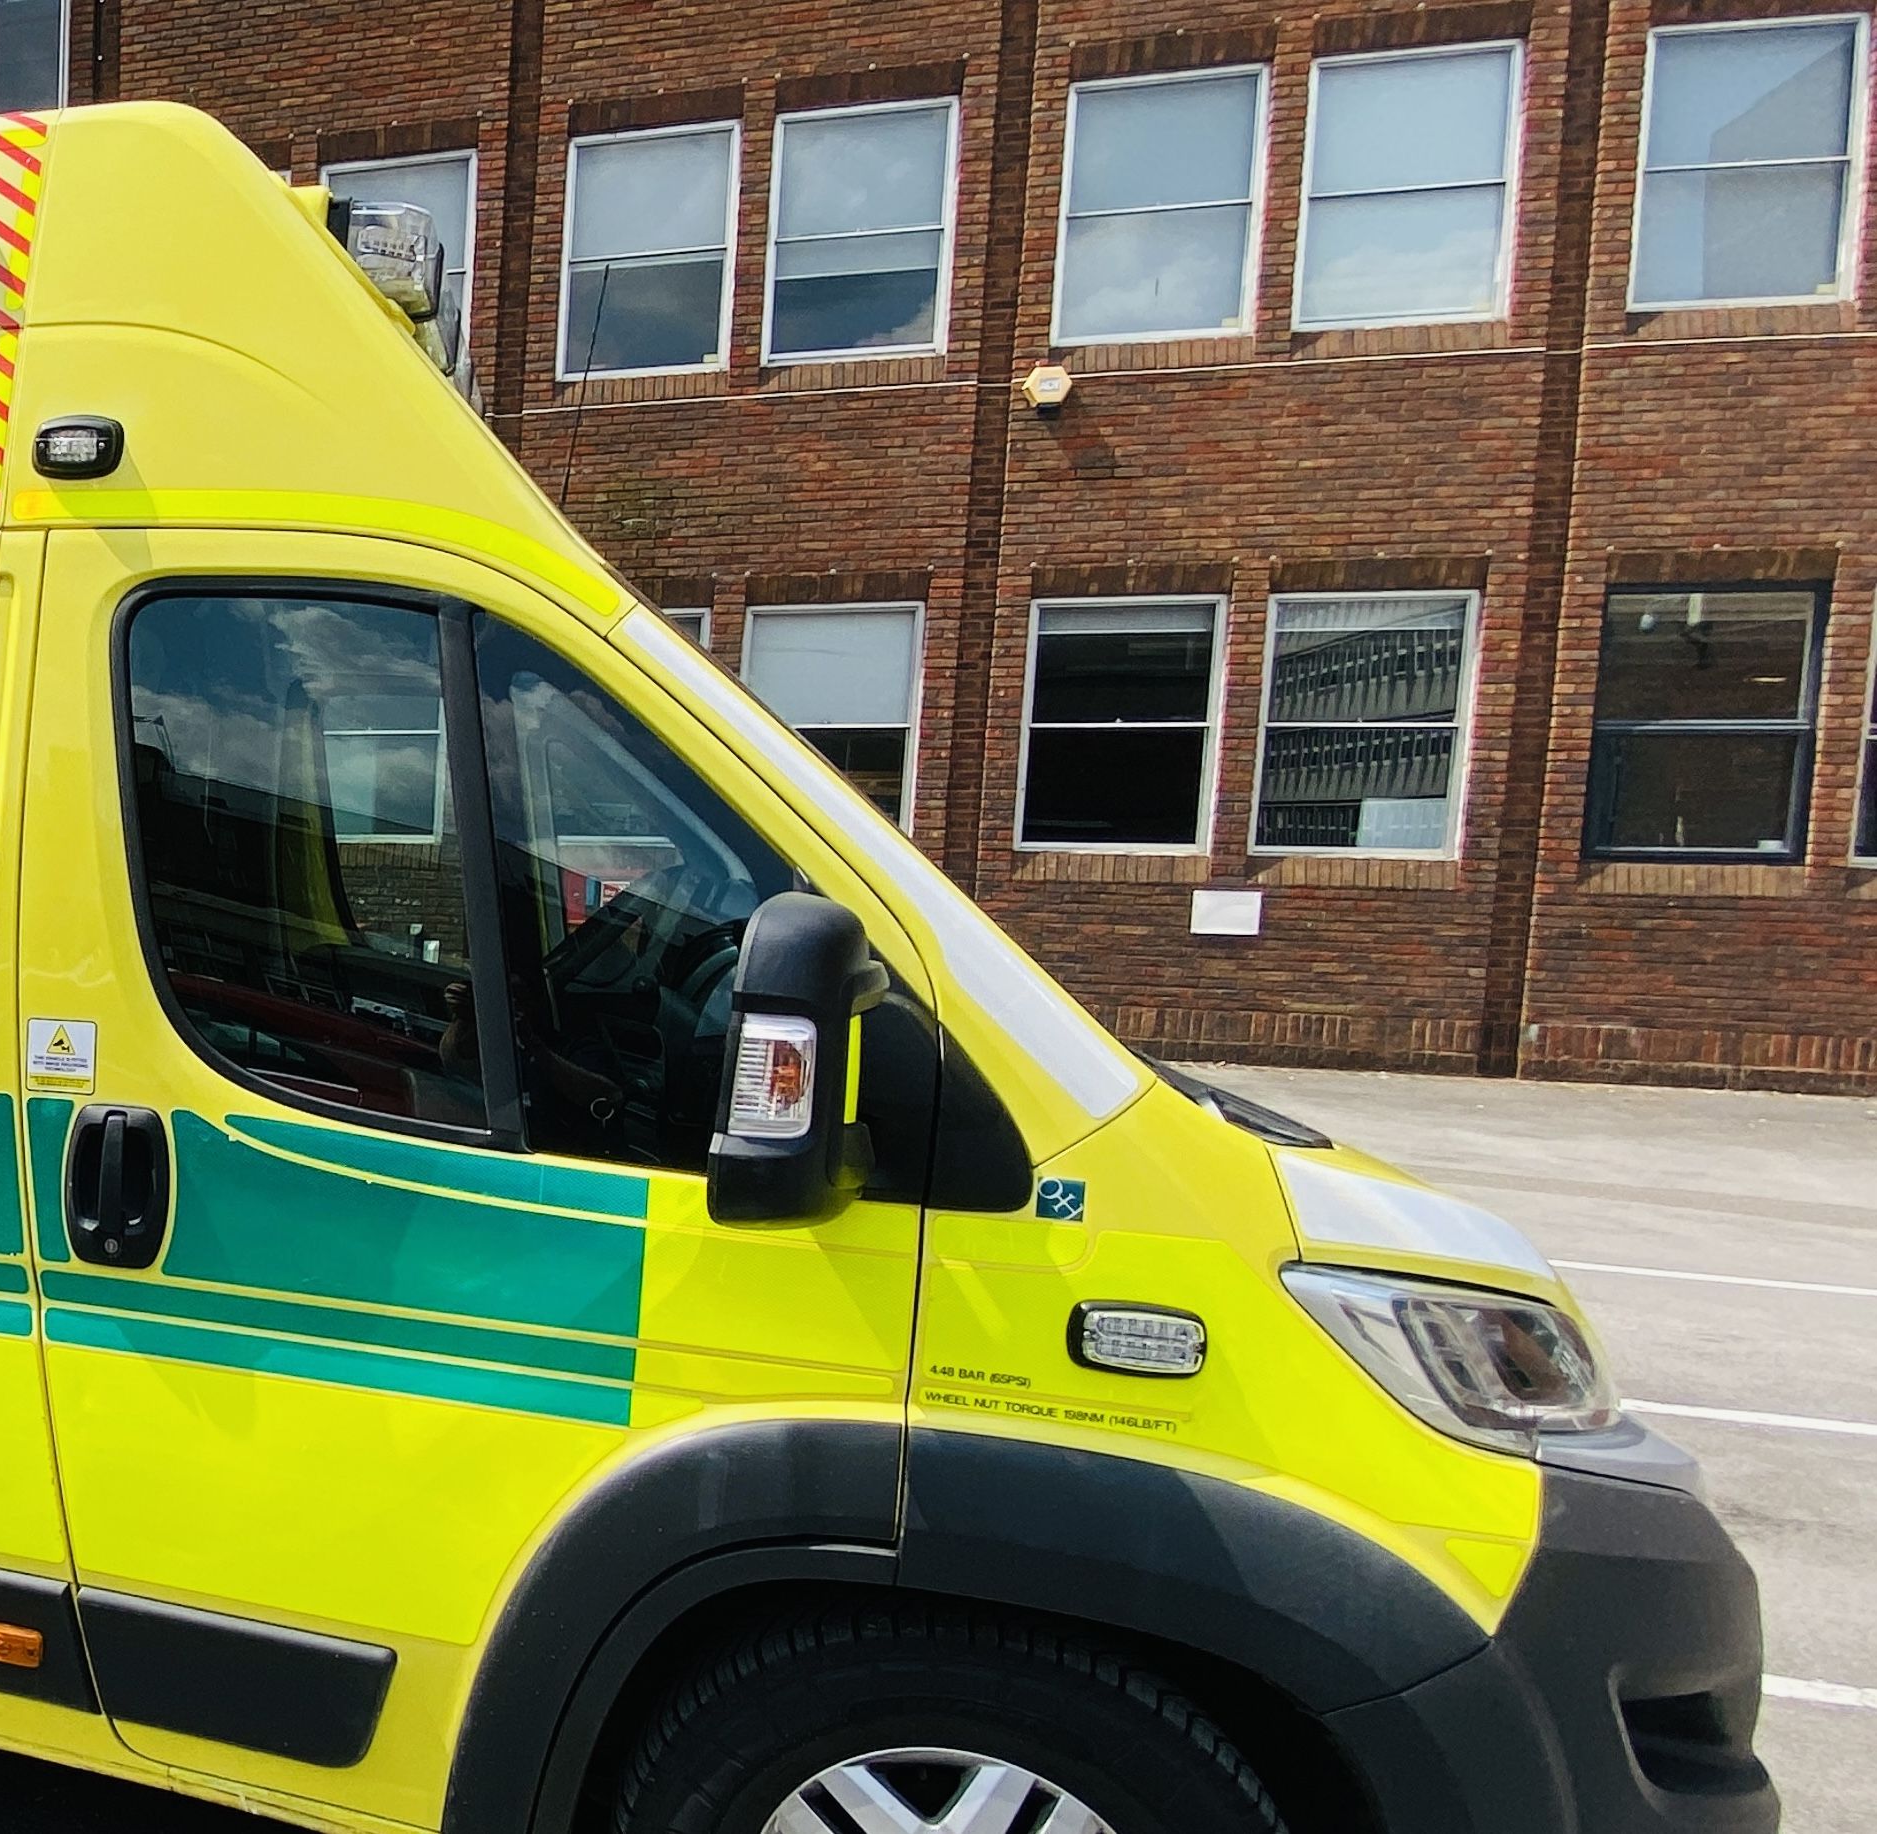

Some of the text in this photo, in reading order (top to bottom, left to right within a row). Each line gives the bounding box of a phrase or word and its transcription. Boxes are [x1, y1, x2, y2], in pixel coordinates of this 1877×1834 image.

[930, 1365, 955, 1377] 4.48
[958, 1368, 985, 1381] BAR
[925, 1391, 970, 1407] WHEEL
[974, 1398, 1001, 1410] NUT
[1005, 1401, 1059, 1418] TORQUE
[1108, 1415, 1178, 1434] (146LB/FT)
